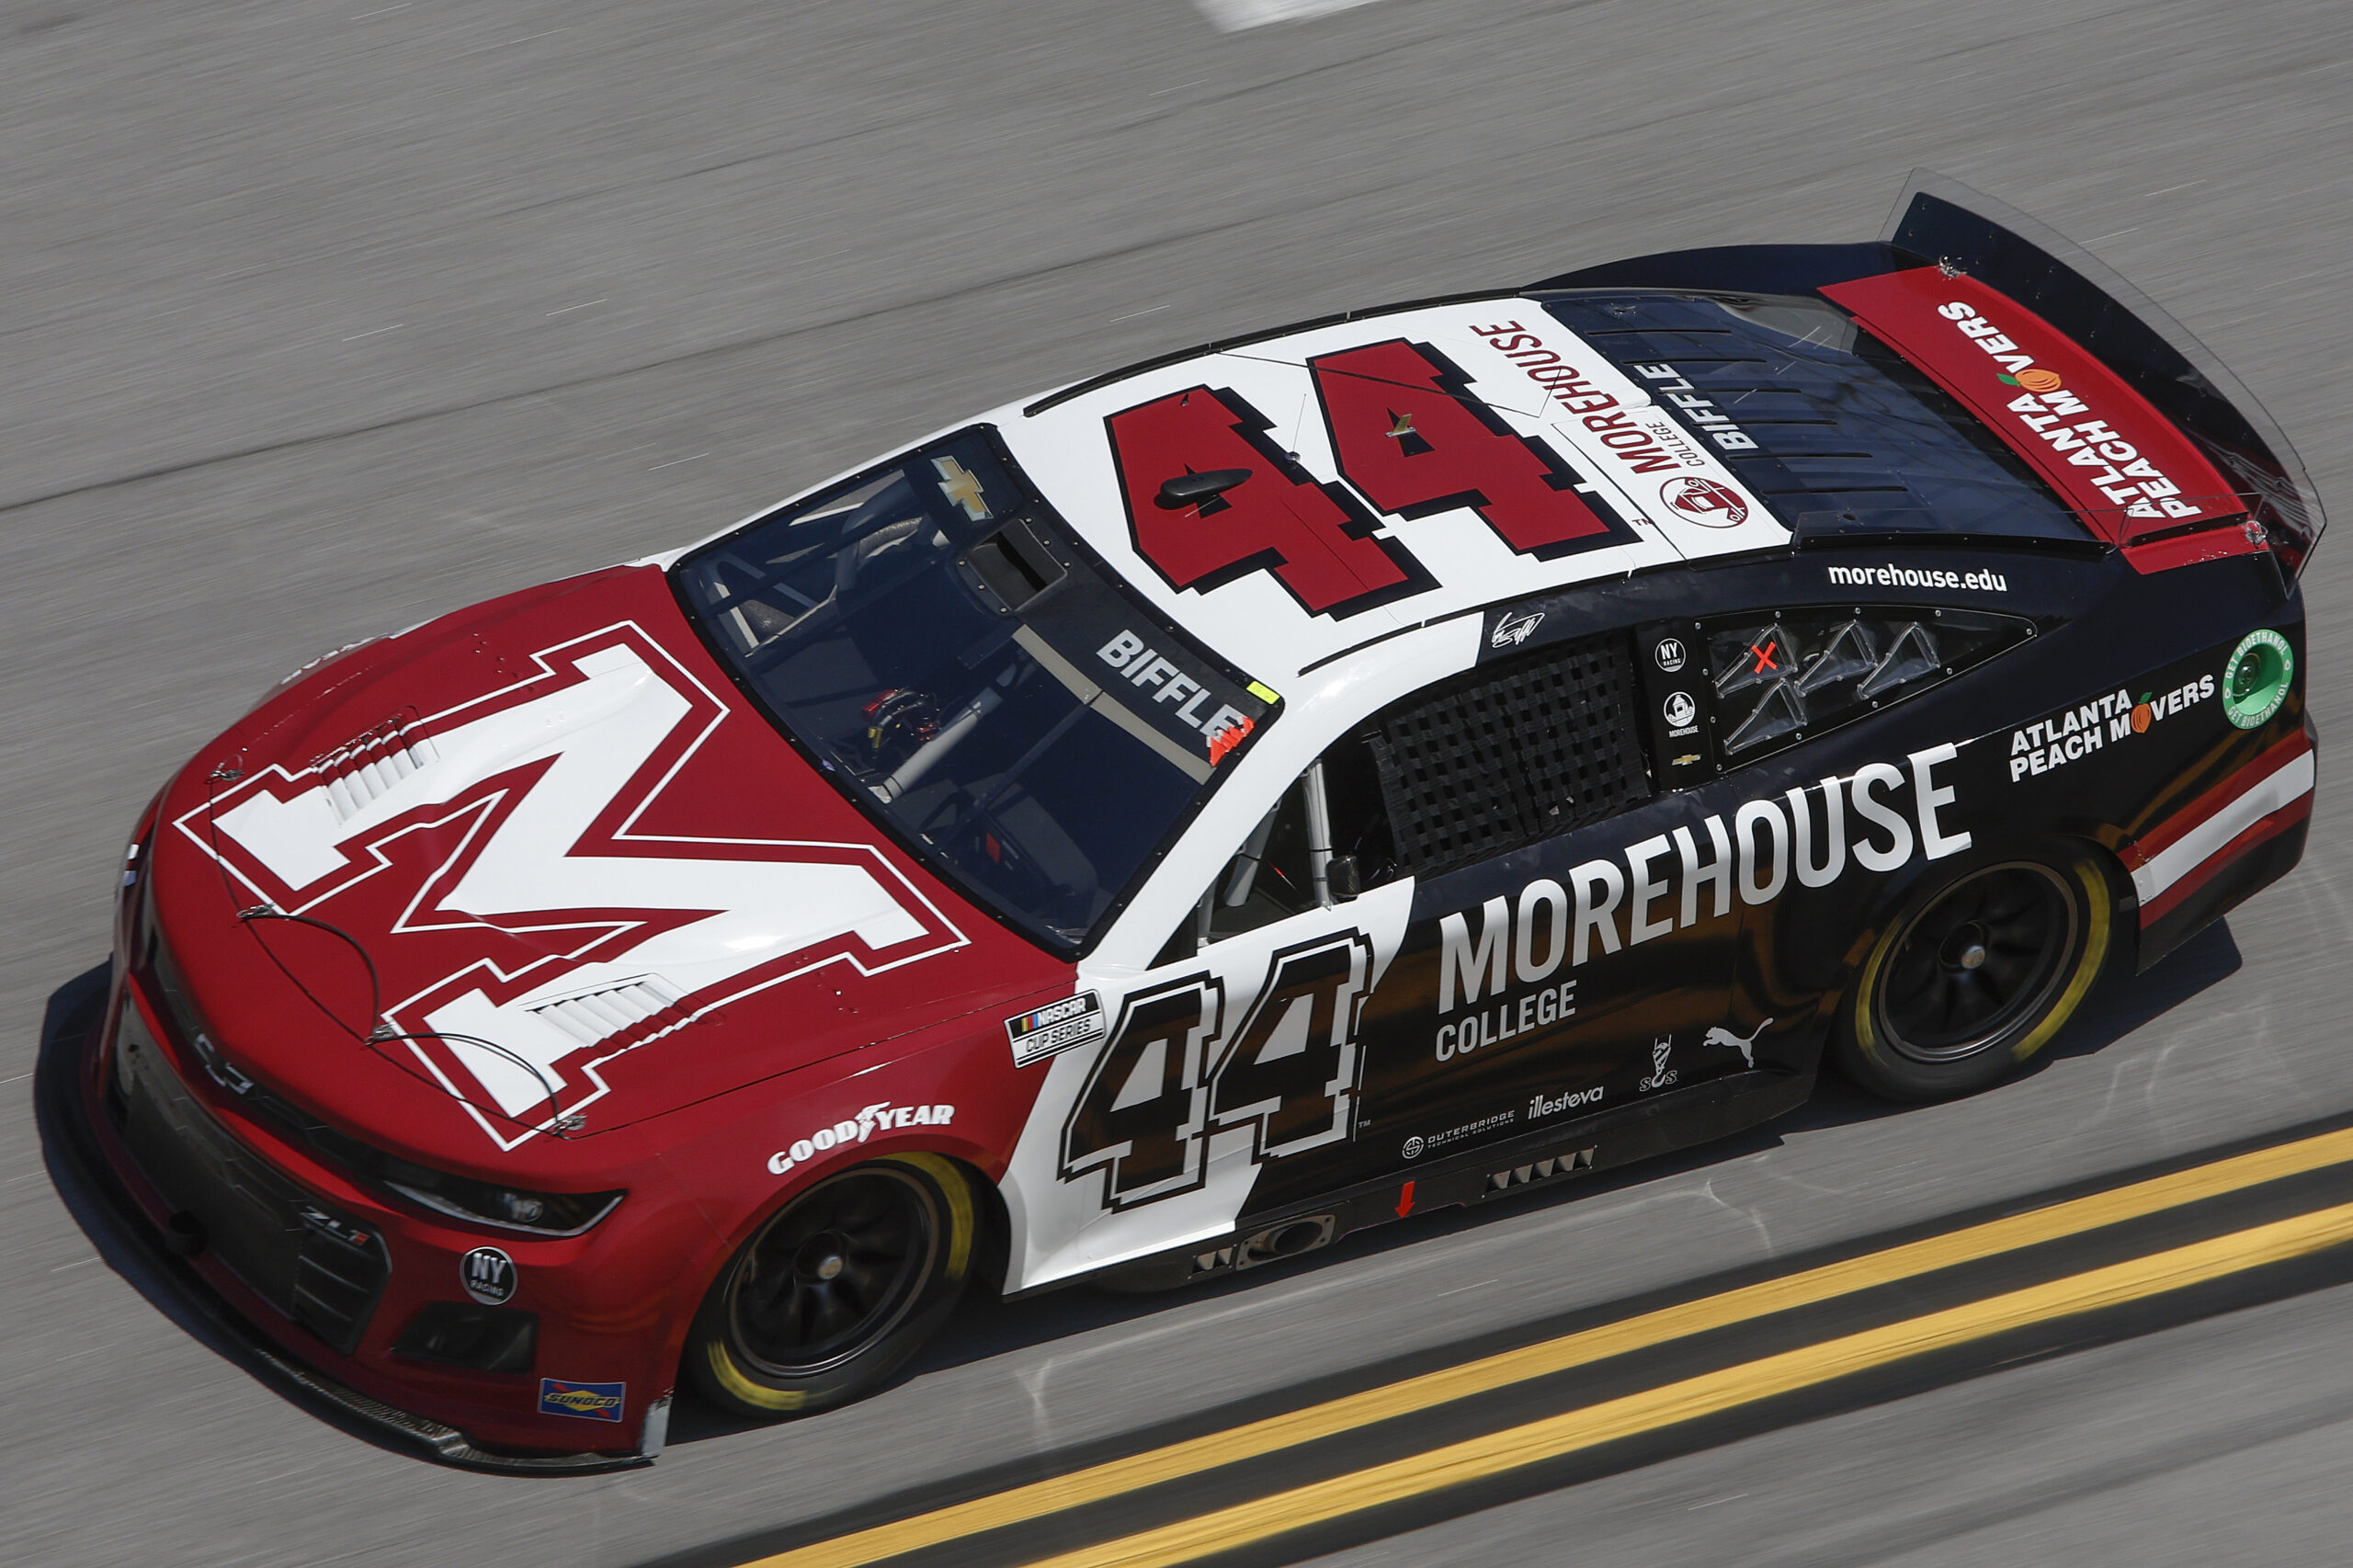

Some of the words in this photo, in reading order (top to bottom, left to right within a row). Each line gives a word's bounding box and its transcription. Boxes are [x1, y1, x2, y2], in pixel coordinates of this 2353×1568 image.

[1469, 320, 1683, 474] MOREHOUSE
[1633, 363, 1759, 450] BIFFLE
[1646, 421, 1705, 467] COLLEGE
[2006, 392, 2166, 518] ATLANTA
[1103, 337, 1643, 621] 44
[2073, 419, 2203, 519] PEACH
[1827, 563, 2007, 592] morehouse.edu
[1660, 642, 1677, 660] NY
[1663, 658, 1681, 666] RACING
[2225, 657, 2239, 678] GET
[2236, 631, 2289, 655] BIOETHANOL
[2010, 689, 2132, 756] ATLANTA
[2228, 705, 2243, 723] GET
[2241, 682, 2288, 727] BIOETHANOL
[1668, 725, 1699, 738] MOREHOUSE
[2009, 731, 2103, 783] PEACH
[1438, 742, 1972, 1015] MOREHOUSE
[1037, 997, 1086, 1027] NASCAR
[1435, 980, 1578, 1062] COLLEGE
[1026, 1033, 1049, 1052] CUP
[1051, 1018, 1091, 1044] SERIES
[1056, 926, 1374, 1214] 44
[1528, 1085, 1604, 1120] illesteva
[767, 1101, 955, 1176] GOODYEAR
[1427, 1109, 1516, 1144] OUTERBRIDGE
[1427, 1132, 1470, 1149] TECHNICAL
[1472, 1118, 1515, 1135] SOLUTIONS
[300, 1206, 370, 1246] ZL1
[471, 1253, 506, 1284] NY
[547, 1392, 619, 1408] SUNOCO
